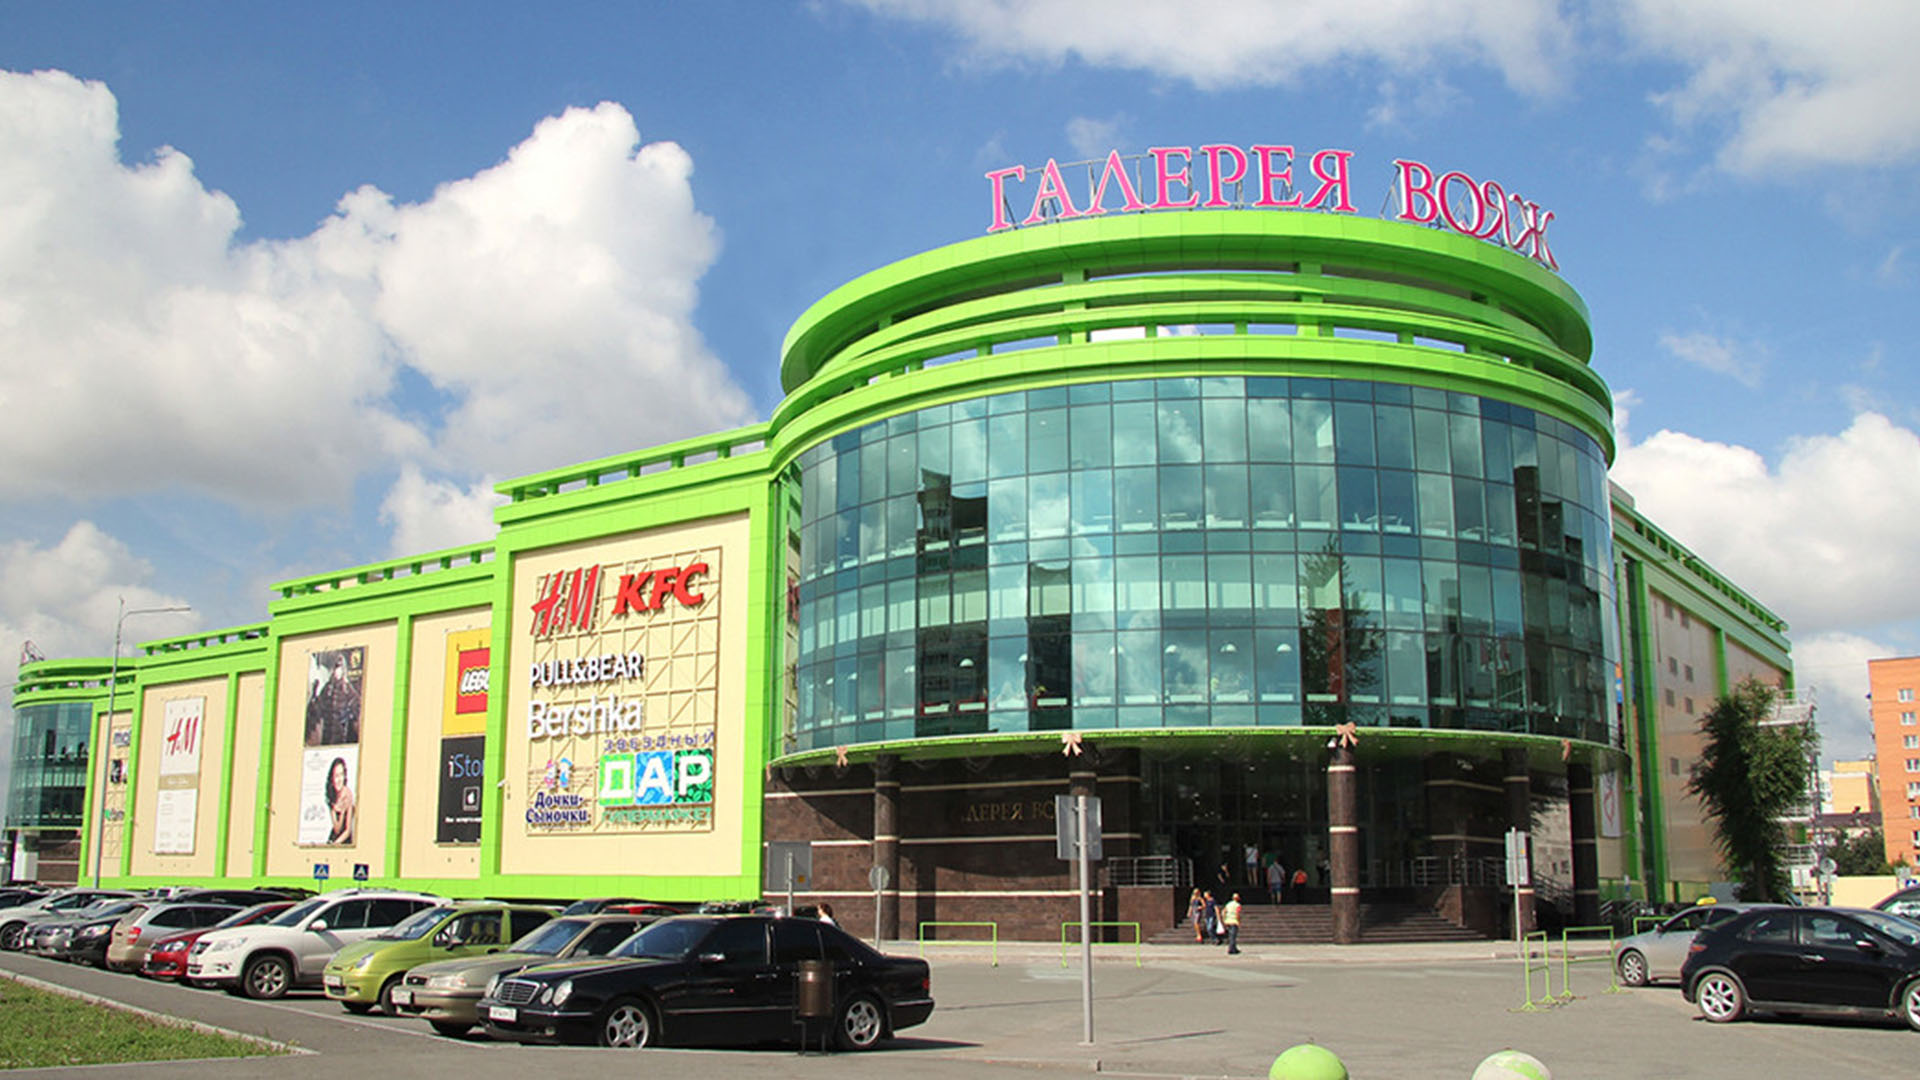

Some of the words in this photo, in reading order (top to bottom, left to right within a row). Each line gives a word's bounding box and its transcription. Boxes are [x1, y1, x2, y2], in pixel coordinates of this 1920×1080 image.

[985, 144, 1359, 233] ГАЛЕРЕЯ
[1393, 158, 1560, 271] ВОЯЖ
[530, 563, 602, 637] H&M
[612, 562, 709, 615] KFC
[530, 652, 644, 688] PULL&BEAR
[528, 694, 642, 739] Bershka
[603, 731, 715, 752] ЗВЕЗДНЫЙ
[600, 753, 711, 799] ДАР
